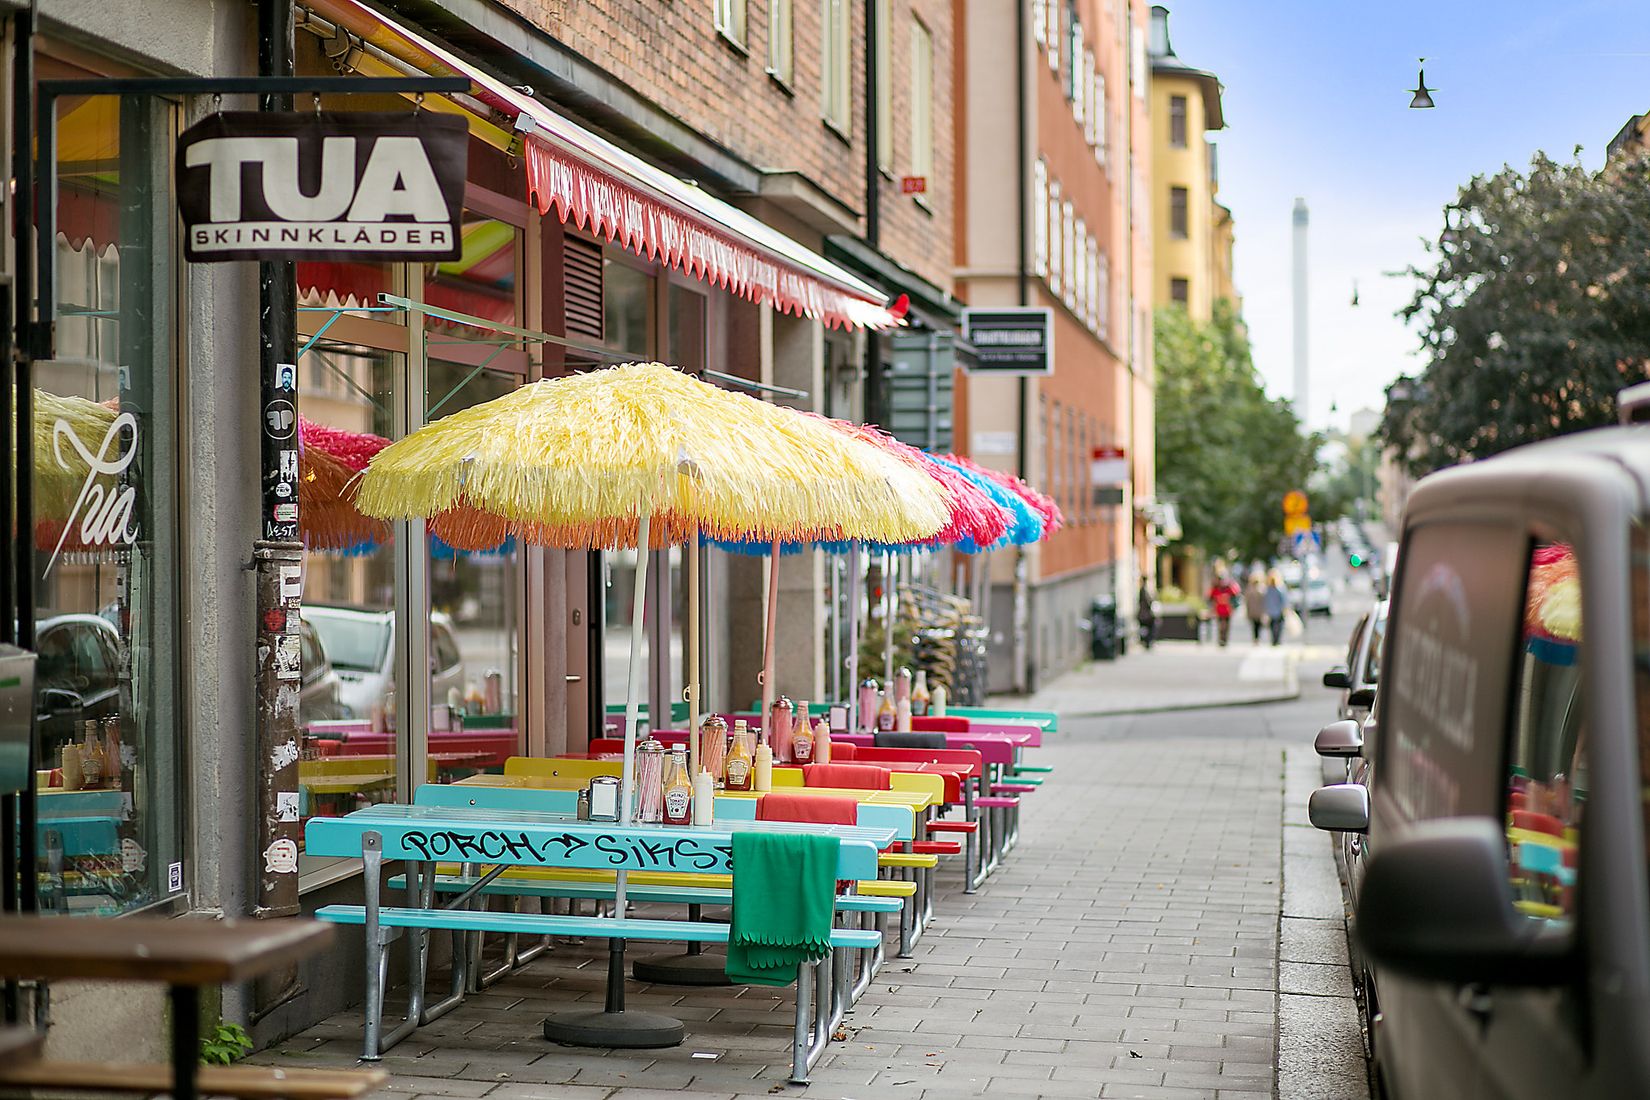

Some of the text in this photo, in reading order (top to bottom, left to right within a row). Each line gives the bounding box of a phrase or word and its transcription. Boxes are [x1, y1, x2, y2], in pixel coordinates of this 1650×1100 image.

[185, 136, 451, 222] TUA
[195, 226, 446, 245] SKINNKLÄDER
[42, 412, 139, 580] Tua
[401, 831, 546, 862] PORCH
